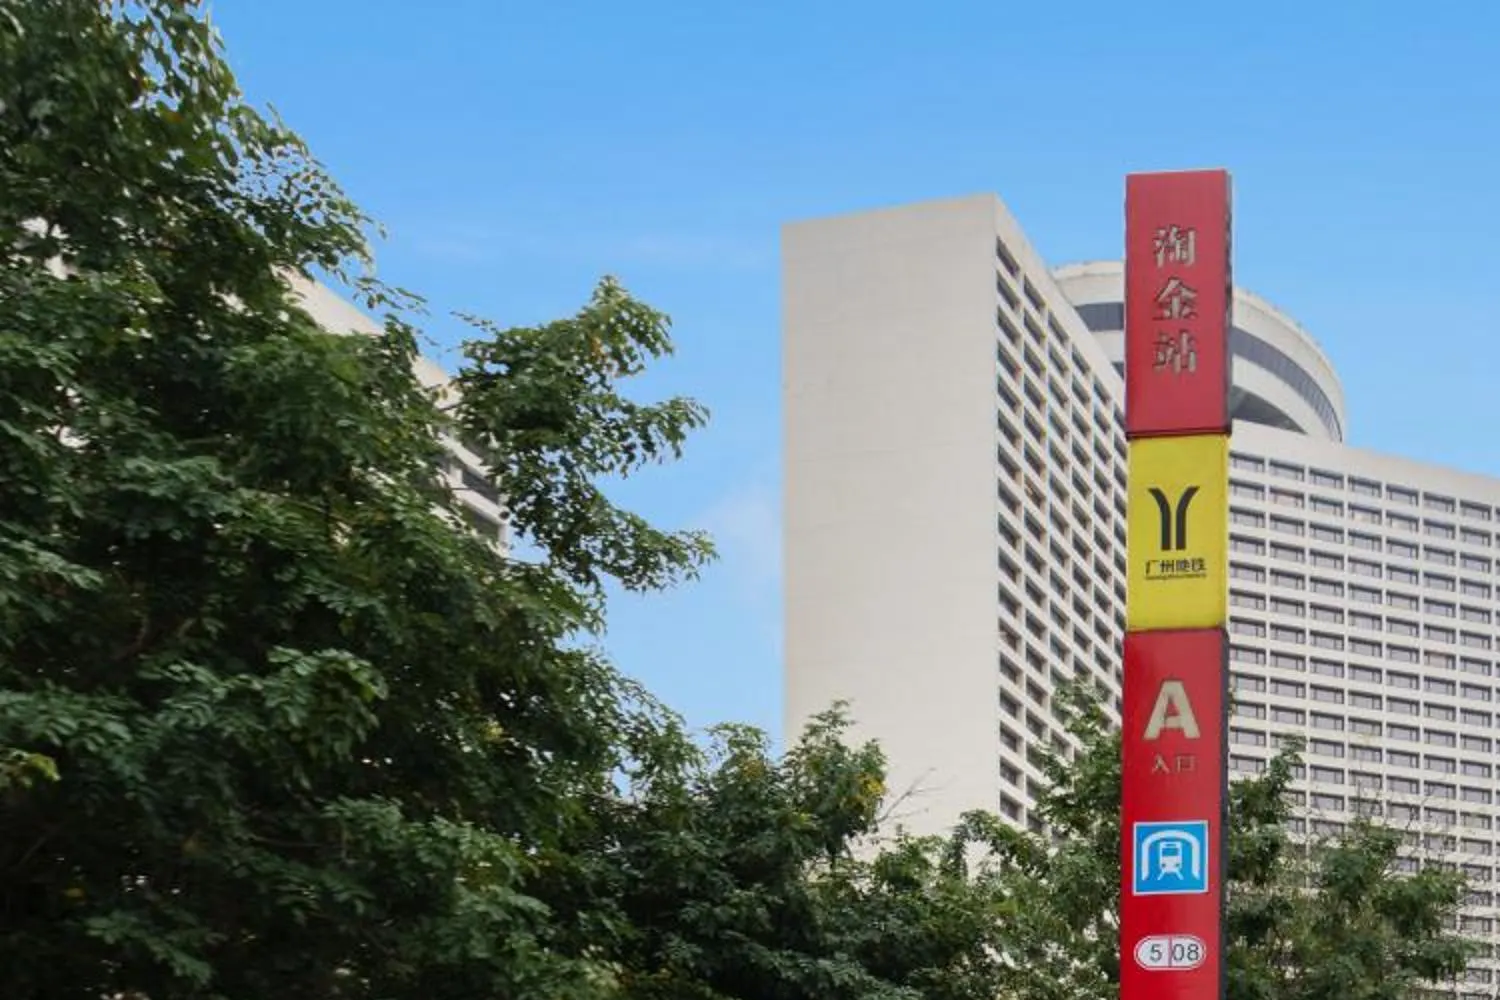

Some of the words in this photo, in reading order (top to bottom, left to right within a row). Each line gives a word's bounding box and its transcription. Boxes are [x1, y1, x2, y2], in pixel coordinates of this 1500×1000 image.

[1152, 223, 1197, 375] 淘金站
[1143, 679, 1201, 740] A
[1151, 753, 1197, 774] 入口
